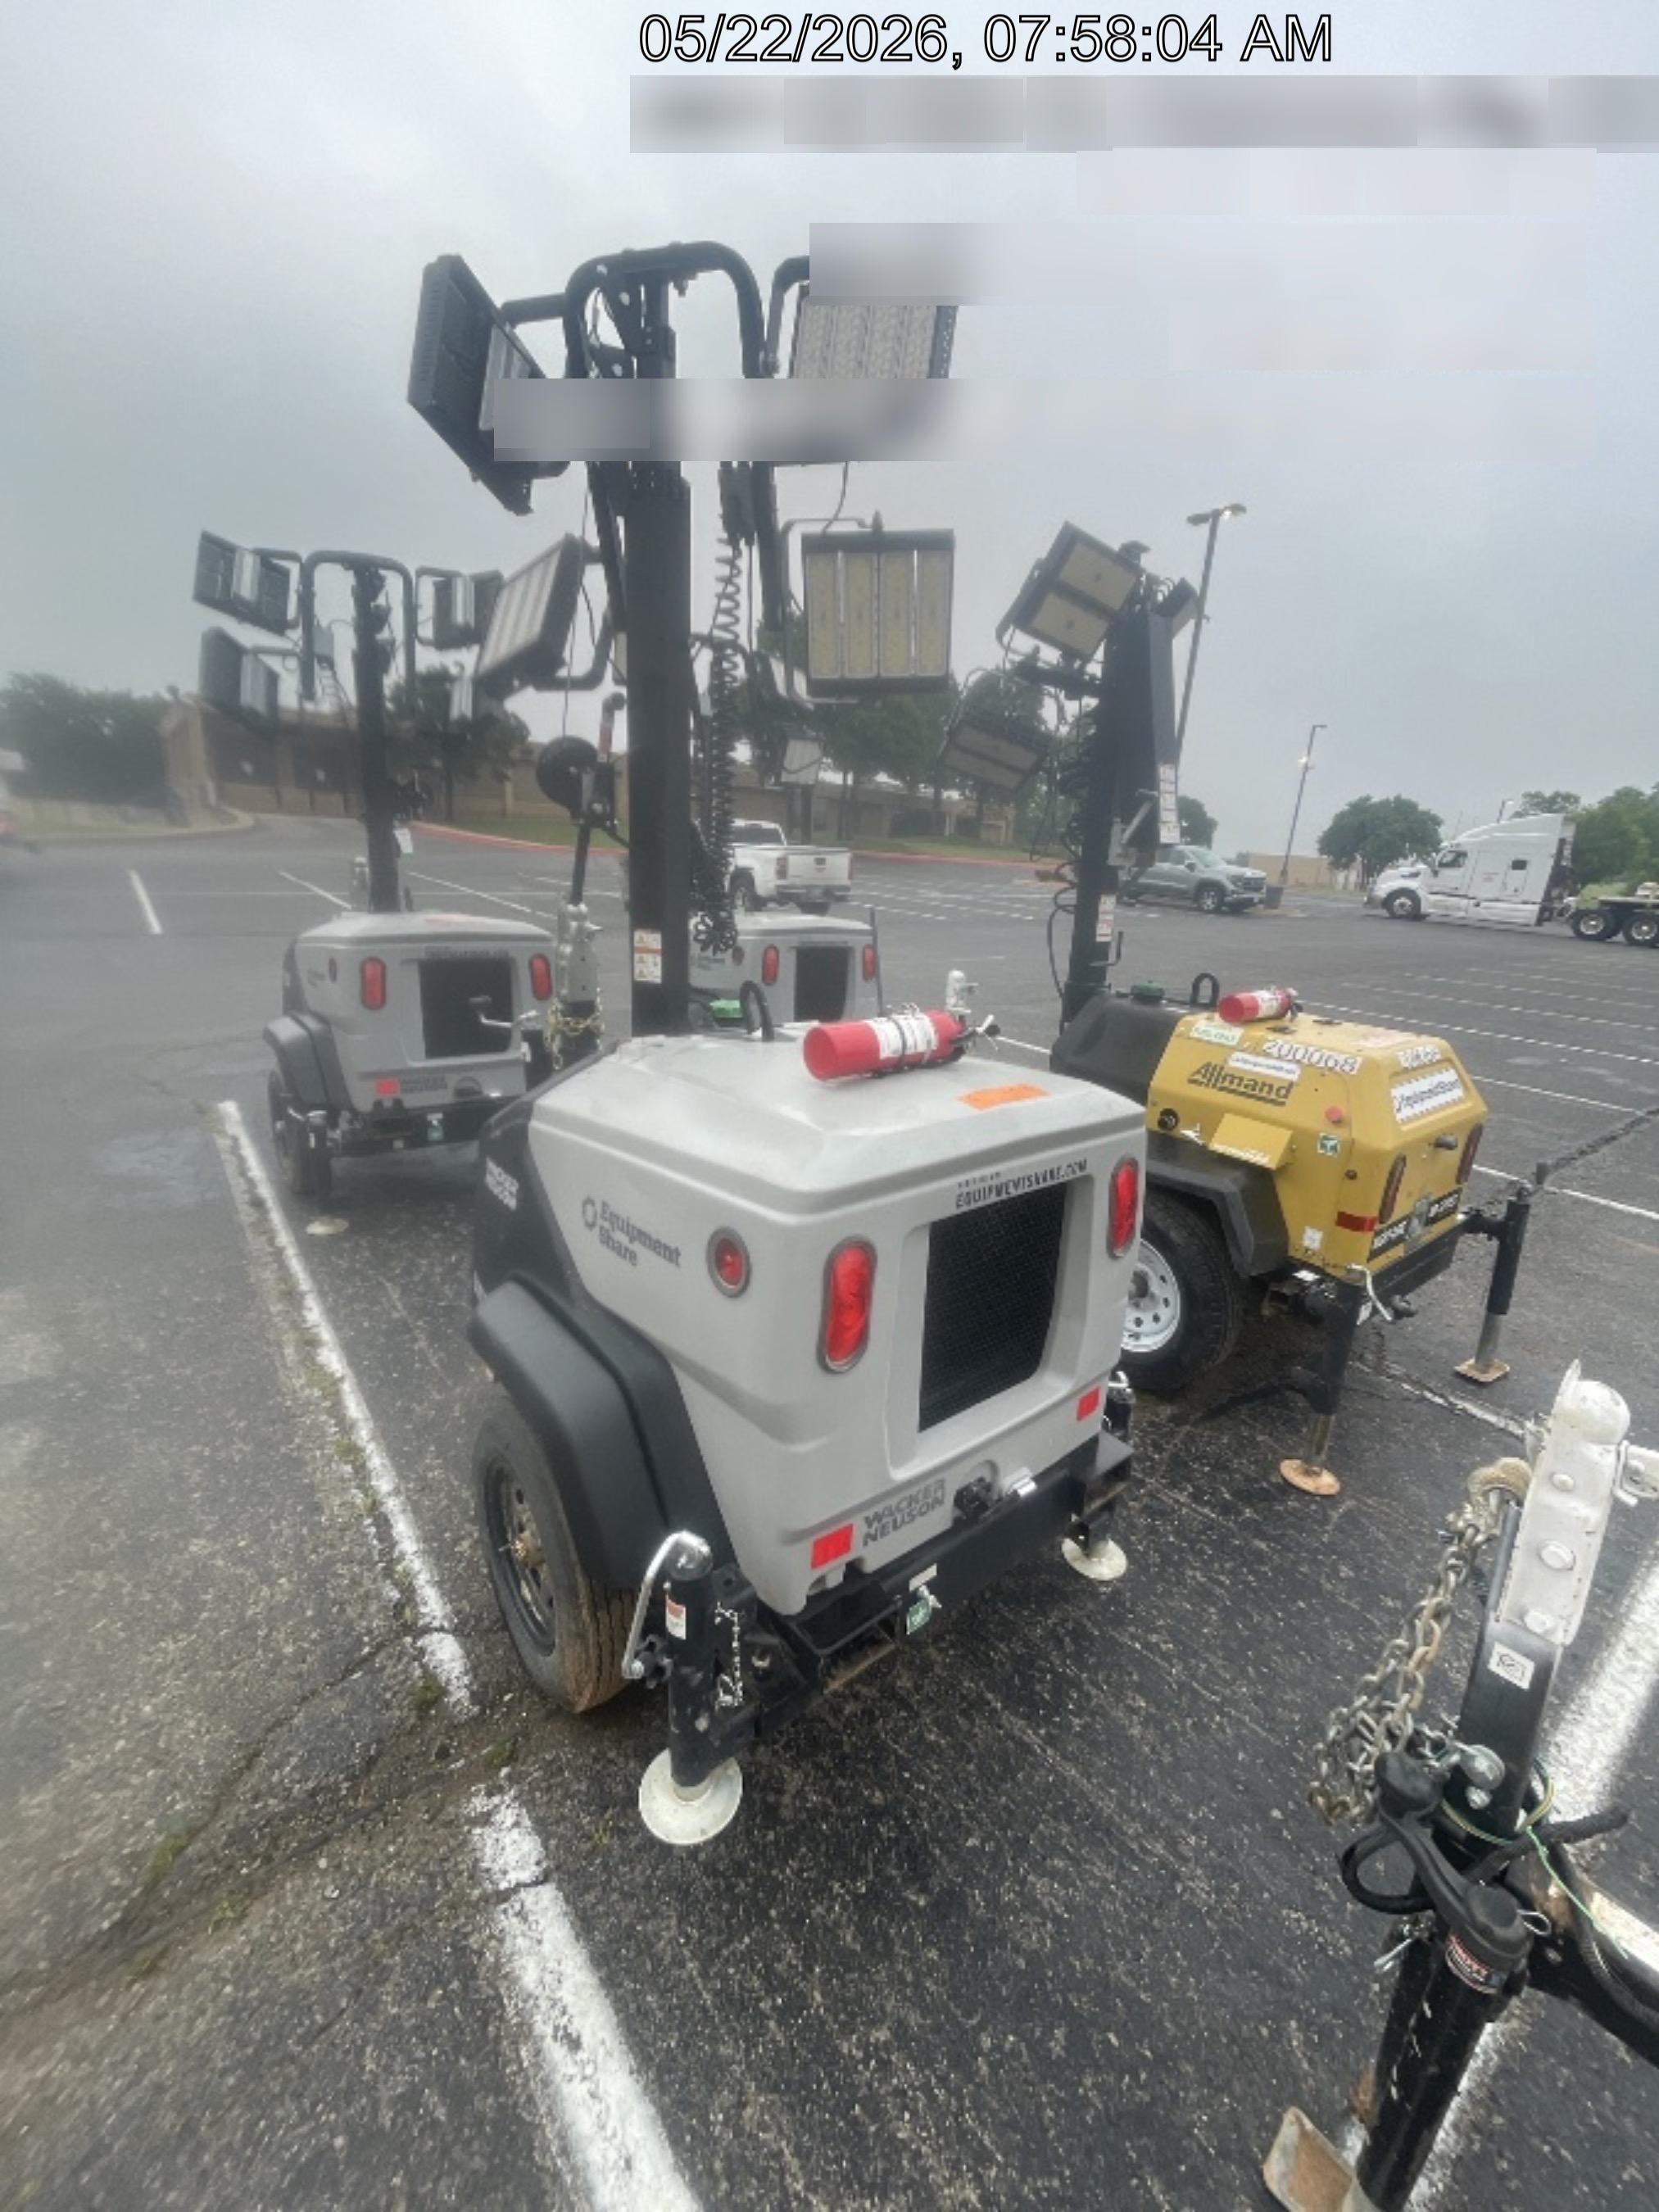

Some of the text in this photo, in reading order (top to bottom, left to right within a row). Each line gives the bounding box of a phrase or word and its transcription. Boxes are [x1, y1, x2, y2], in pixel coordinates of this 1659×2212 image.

[1190, 1062, 1294, 1100] Allmand
[600, 1199, 682, 1268] Equipment
[862, 1496, 945, 1547] NEUSON
[864, 1478, 945, 1530] WACKER
